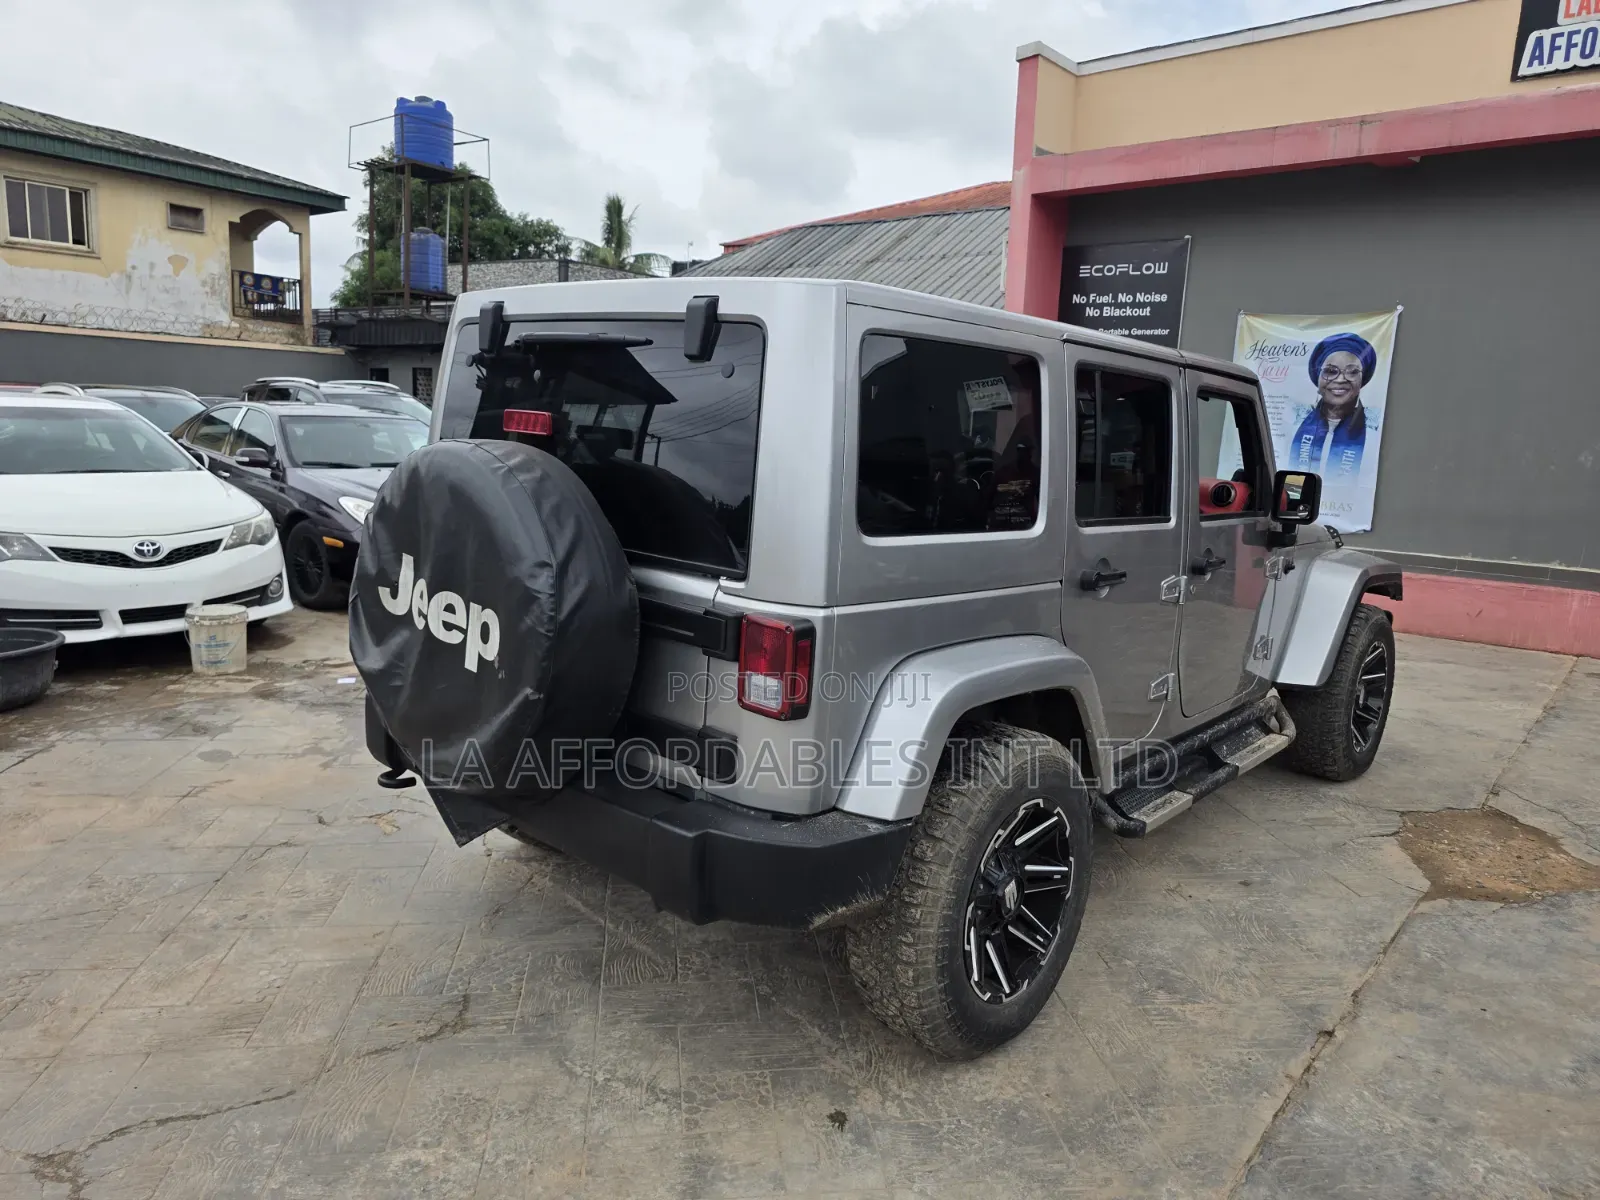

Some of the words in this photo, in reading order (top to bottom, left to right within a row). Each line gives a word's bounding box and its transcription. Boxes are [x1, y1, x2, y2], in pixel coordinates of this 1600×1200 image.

[1526, 26, 1600, 68] AFFO
[1079, 262, 1169, 277] ECOFLOW
[1072, 294, 1087, 304] No
[1089, 293, 1115, 304] Fuel.
[1118, 292, 1133, 303] No
[1136, 292, 1168, 303] Noise
[1085, 306, 1100, 317] No
[1102, 306, 1151, 317] Blackout
[1245, 339, 1309, 361] Heaven's
[1299, 434, 1314, 463] EZINNE
[1320, 500, 1354, 512] BBAS
[378, 552, 500, 673] Jeep
